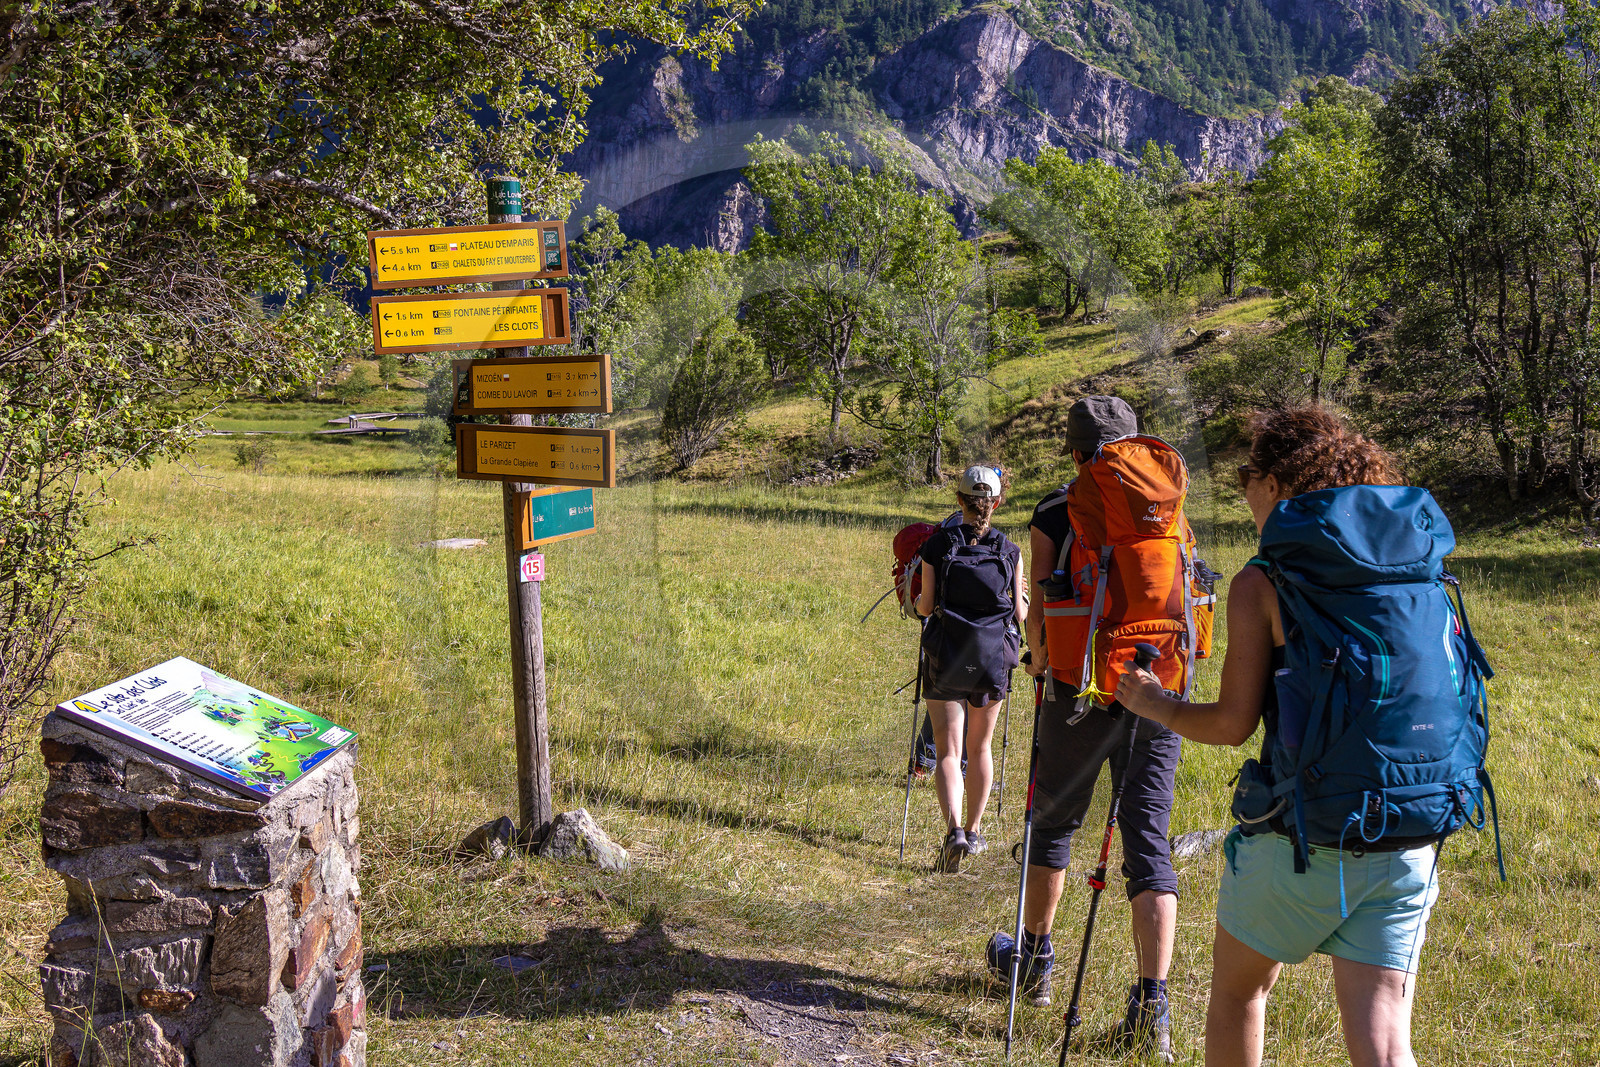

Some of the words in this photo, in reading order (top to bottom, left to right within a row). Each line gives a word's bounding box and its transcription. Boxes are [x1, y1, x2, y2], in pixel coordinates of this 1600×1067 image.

[460, 240, 494, 250] PLATEAU
[496, 238, 534, 248] D'EMPARIS
[453, 258, 476, 268] CHALETS
[477, 258, 485, 266] DU
[486, 257, 496, 266] FAY
[497, 256, 503, 265] ET
[504, 255, 536, 264] MOUTERRES
[454, 307, 490, 317] FONTAINE
[492, 304, 538, 316] PÉTRIFIANTE
[396, 330, 408, 338] 0.6
[494, 323, 509, 332] LES
[512, 322, 539, 331] CLOTS
[477, 390, 500, 399] COMBE
[503, 390, 512, 398] DU
[514, 390, 537, 398] LAVOIR
[480, 440, 488, 448] LE
[490, 441, 516, 450] PARIZET
[581, 445, 591, 454] km
[480, 456, 488, 464] La
[489, 457, 512, 466] Grande
[514, 458, 538, 468] Clapière
[582, 462, 591, 470] km
[526, 561, 539, 574] 15
[83, 700, 113, 709] Le
[120, 686, 145, 697] des
